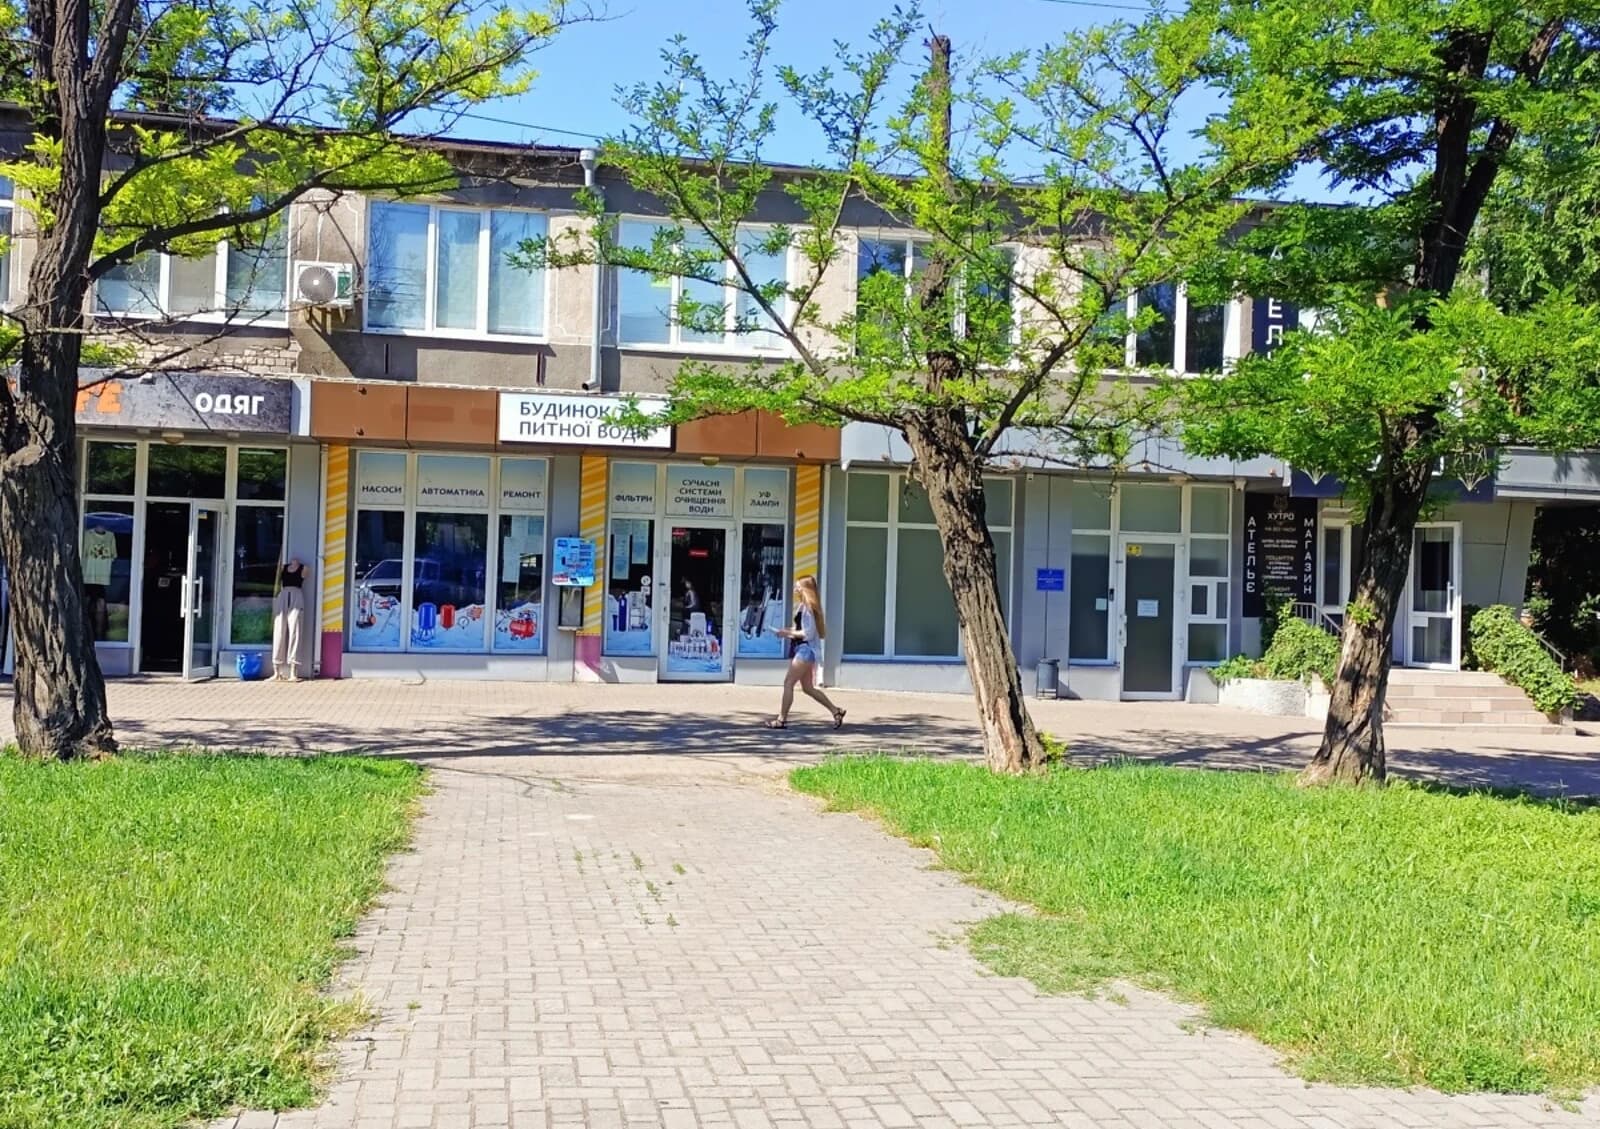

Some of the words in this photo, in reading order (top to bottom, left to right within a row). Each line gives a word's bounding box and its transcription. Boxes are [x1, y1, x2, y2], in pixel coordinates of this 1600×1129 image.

[195, 392, 265, 415] ОДЯГ
[520, 401, 611, 420] БУДИНОК
[519, 420, 592, 438] ПИТНОЇ
[682, 479, 720, 487] СУЧАСНІ
[362, 485, 402, 494] НАСОСИ
[421, 487, 485, 497] АВТОМАТИКА
[680, 487, 722, 497] СИСТЕМИ
[759, 490, 772, 498] УФ
[503, 491, 541, 499] РЕМОНТ
[615, 494, 652, 503] ФІЛЬТРИ
[674, 496, 726, 505] ОЧИЩЕННЯ
[750, 498, 780, 508] ЛАМПИ
[689, 505, 714, 514] ВОДИ
[1267, 512, 1295, 521] ХУТРО
[1246, 515, 1257, 593] АТЕЛЬЄ
[1303, 518, 1314, 595] МАГАЗИН
